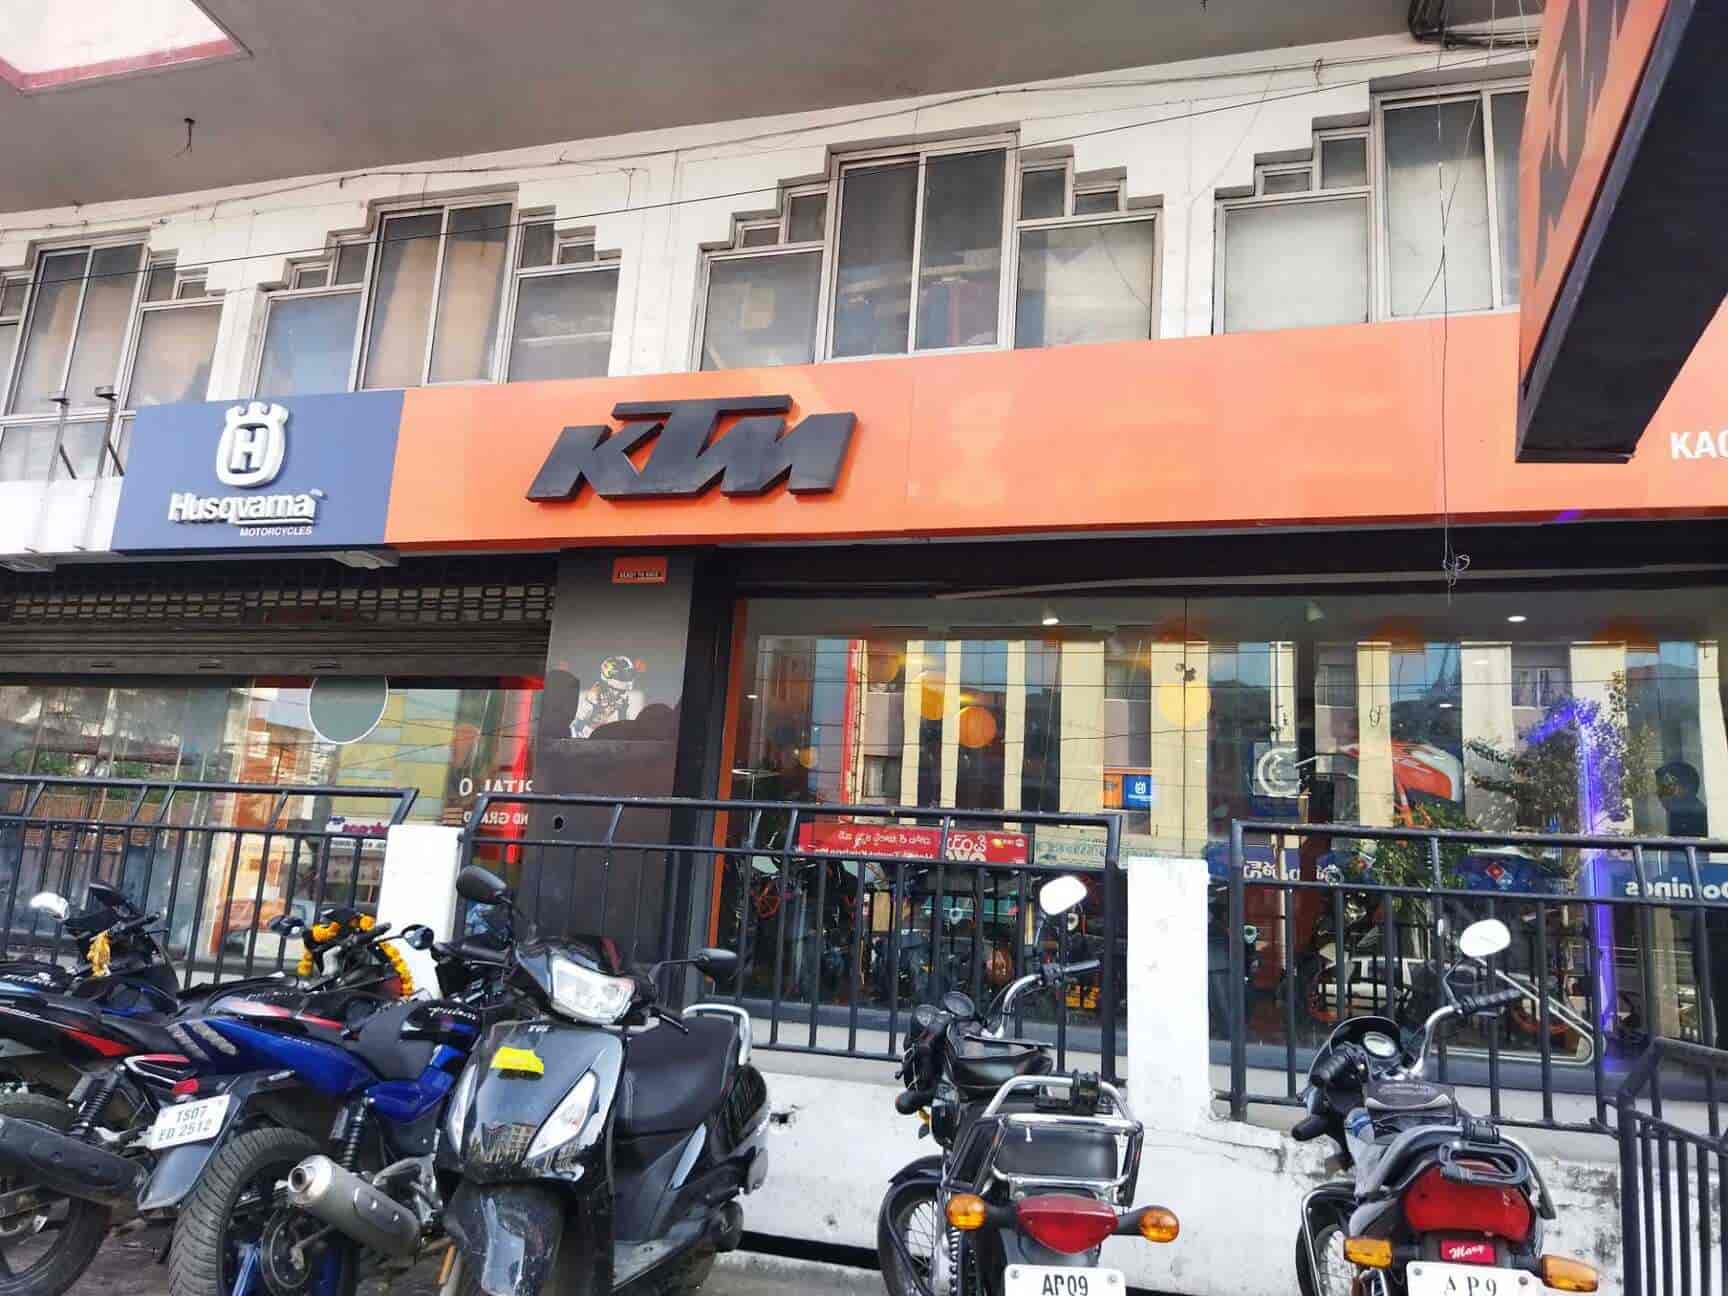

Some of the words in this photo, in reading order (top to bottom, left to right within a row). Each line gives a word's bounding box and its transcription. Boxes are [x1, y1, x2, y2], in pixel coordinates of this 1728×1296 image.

[526, 395, 857, 502] KTM
[168, 492, 316, 524] Husqvarna
[240, 527, 312, 537] MOTORCYCLES
[1042, 1273, 1089, 1296] AP09
